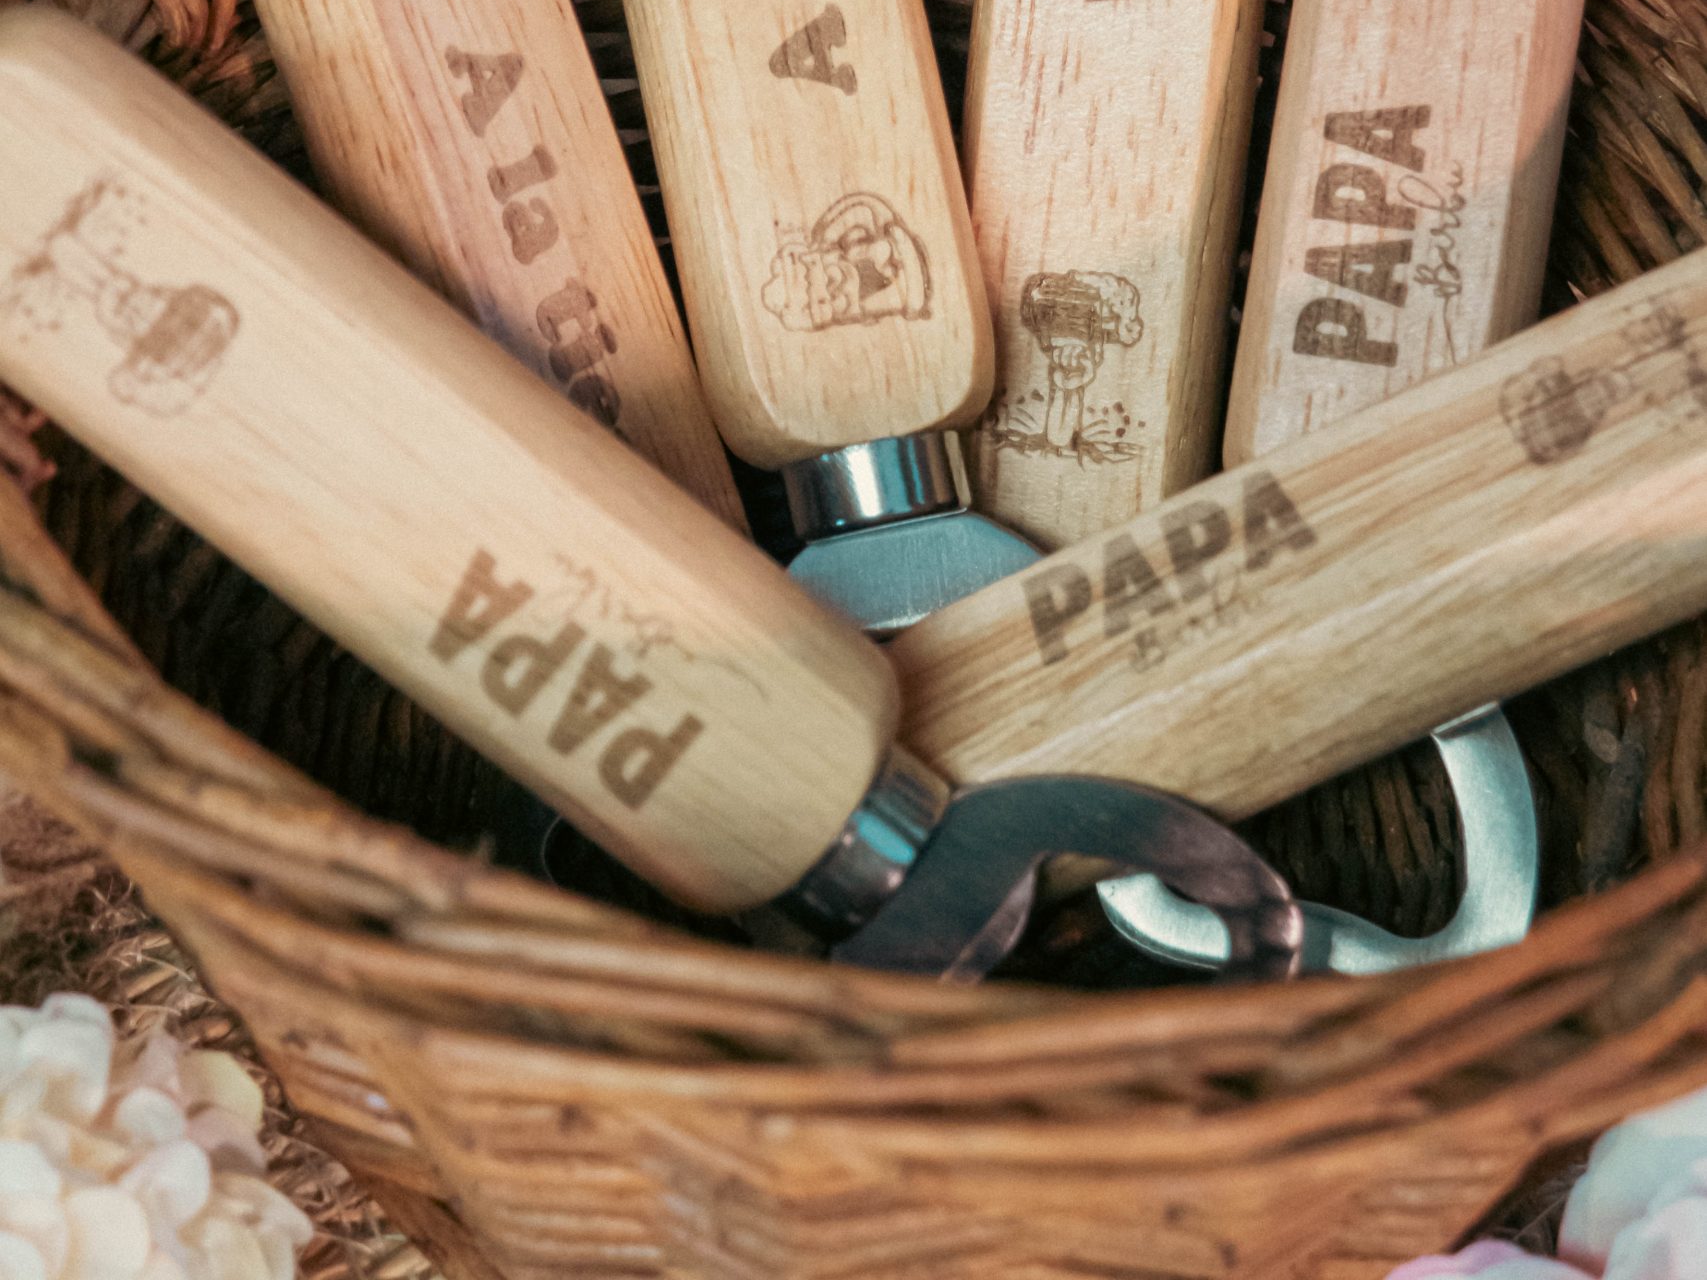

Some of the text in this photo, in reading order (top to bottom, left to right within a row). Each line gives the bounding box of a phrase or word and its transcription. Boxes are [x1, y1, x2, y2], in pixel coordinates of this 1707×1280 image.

[444, 44, 525, 138] A
[487, 144, 560, 266] la
[768, 2, 860, 97] A
[1292, 104, 1432, 369] PAPA
[1398, 160, 1466, 366] Barbu
[1021, 469, 1320, 667] PAPA
[427, 547, 705, 814] PAPA
